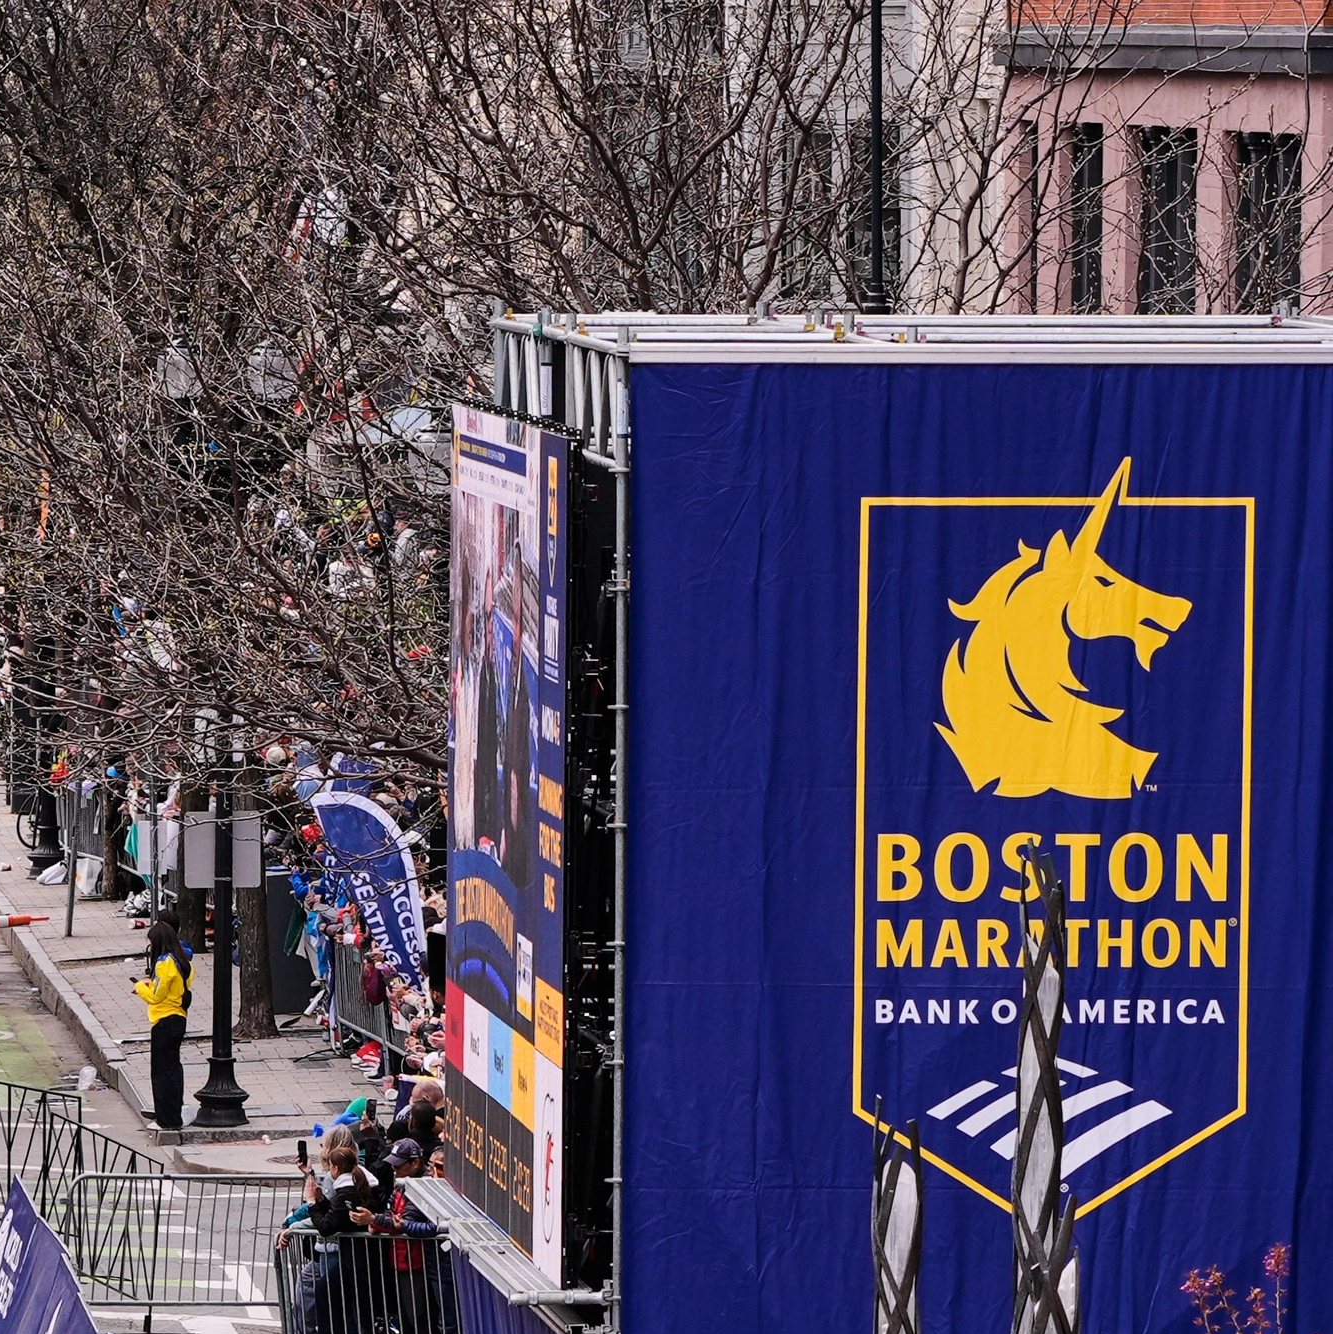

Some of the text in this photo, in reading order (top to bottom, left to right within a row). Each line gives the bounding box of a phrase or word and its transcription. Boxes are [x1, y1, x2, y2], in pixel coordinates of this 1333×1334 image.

[876, 832, 1228, 903] BOSTON
[350, 872, 401, 964] SEATING
[875, 999, 981, 1024] BANK
[992, 999, 1025, 1024] O
